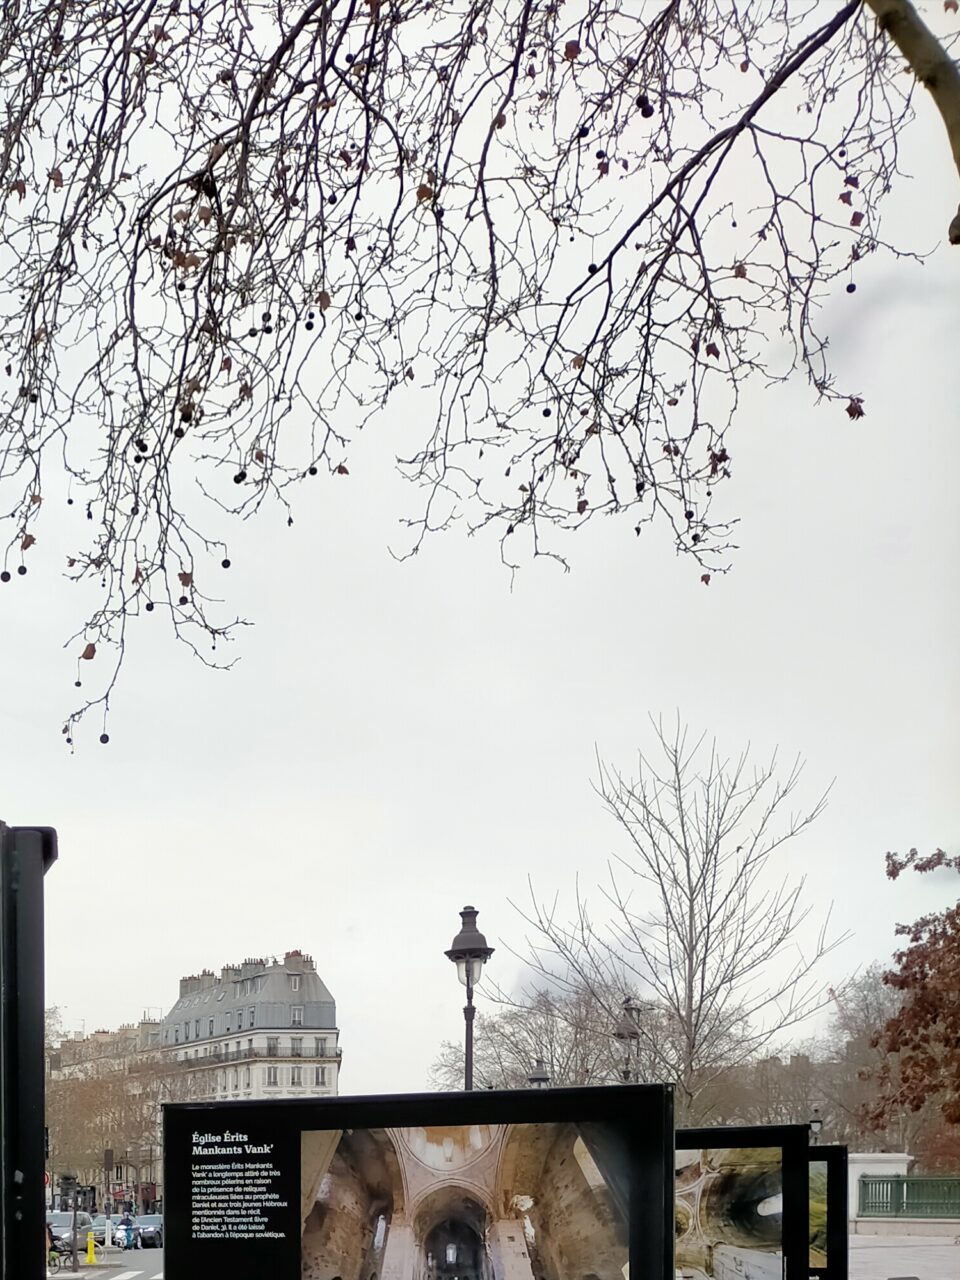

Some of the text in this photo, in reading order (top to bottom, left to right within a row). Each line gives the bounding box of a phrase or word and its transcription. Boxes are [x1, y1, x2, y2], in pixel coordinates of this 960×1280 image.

[192, 1130, 248, 1145] Église Érits
[192, 1145, 242, 1155] Mankants
